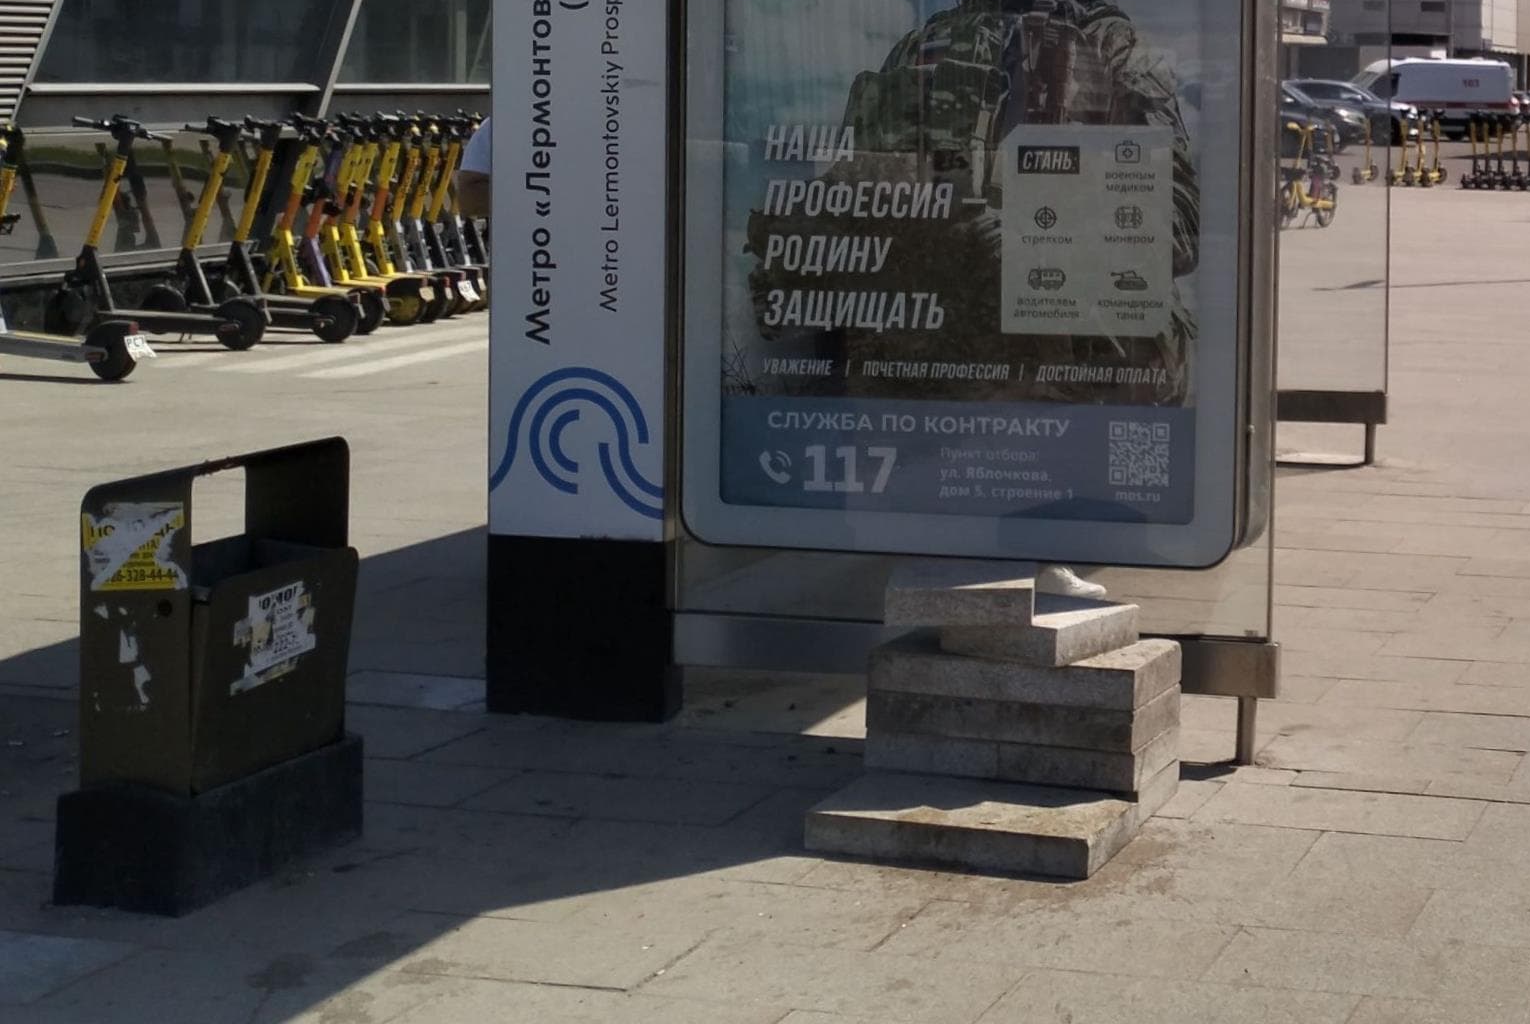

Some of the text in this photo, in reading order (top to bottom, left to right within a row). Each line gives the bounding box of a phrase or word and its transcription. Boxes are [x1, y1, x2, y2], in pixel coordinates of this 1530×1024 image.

[601, 61, 623, 231] Lermontovskiy
[764, 124, 855, 162] НАША
[1022, 149, 1077, 171] СТАНЬ:
[763, 179, 954, 219] ПРОФЕССИЯ
[763, 234, 893, 276] РОДИНУ
[525, 227, 557, 345] Метро
[600, 240, 619, 312] Metro
[763, 289, 945, 333] ЗАЩИЩАТЬ
[762, 358, 1168, 385] УВАЖЕНИЕ ПОЧЕТНАЯ ПРОФЕССИЯ ДОСТОЙНАЯ ОПЛАТА
[767, 411, 1071, 437] СЛУЖБА ПО КОНТРАКТУ
[803, 444, 898, 494] 117
[940, 447, 981, 464] Пункт
[940, 468, 961, 481] ул.
[939, 484, 970, 499] дом
[991, 487, 1063, 501] строение
[1115, 491, 1161, 502] mos.ru
